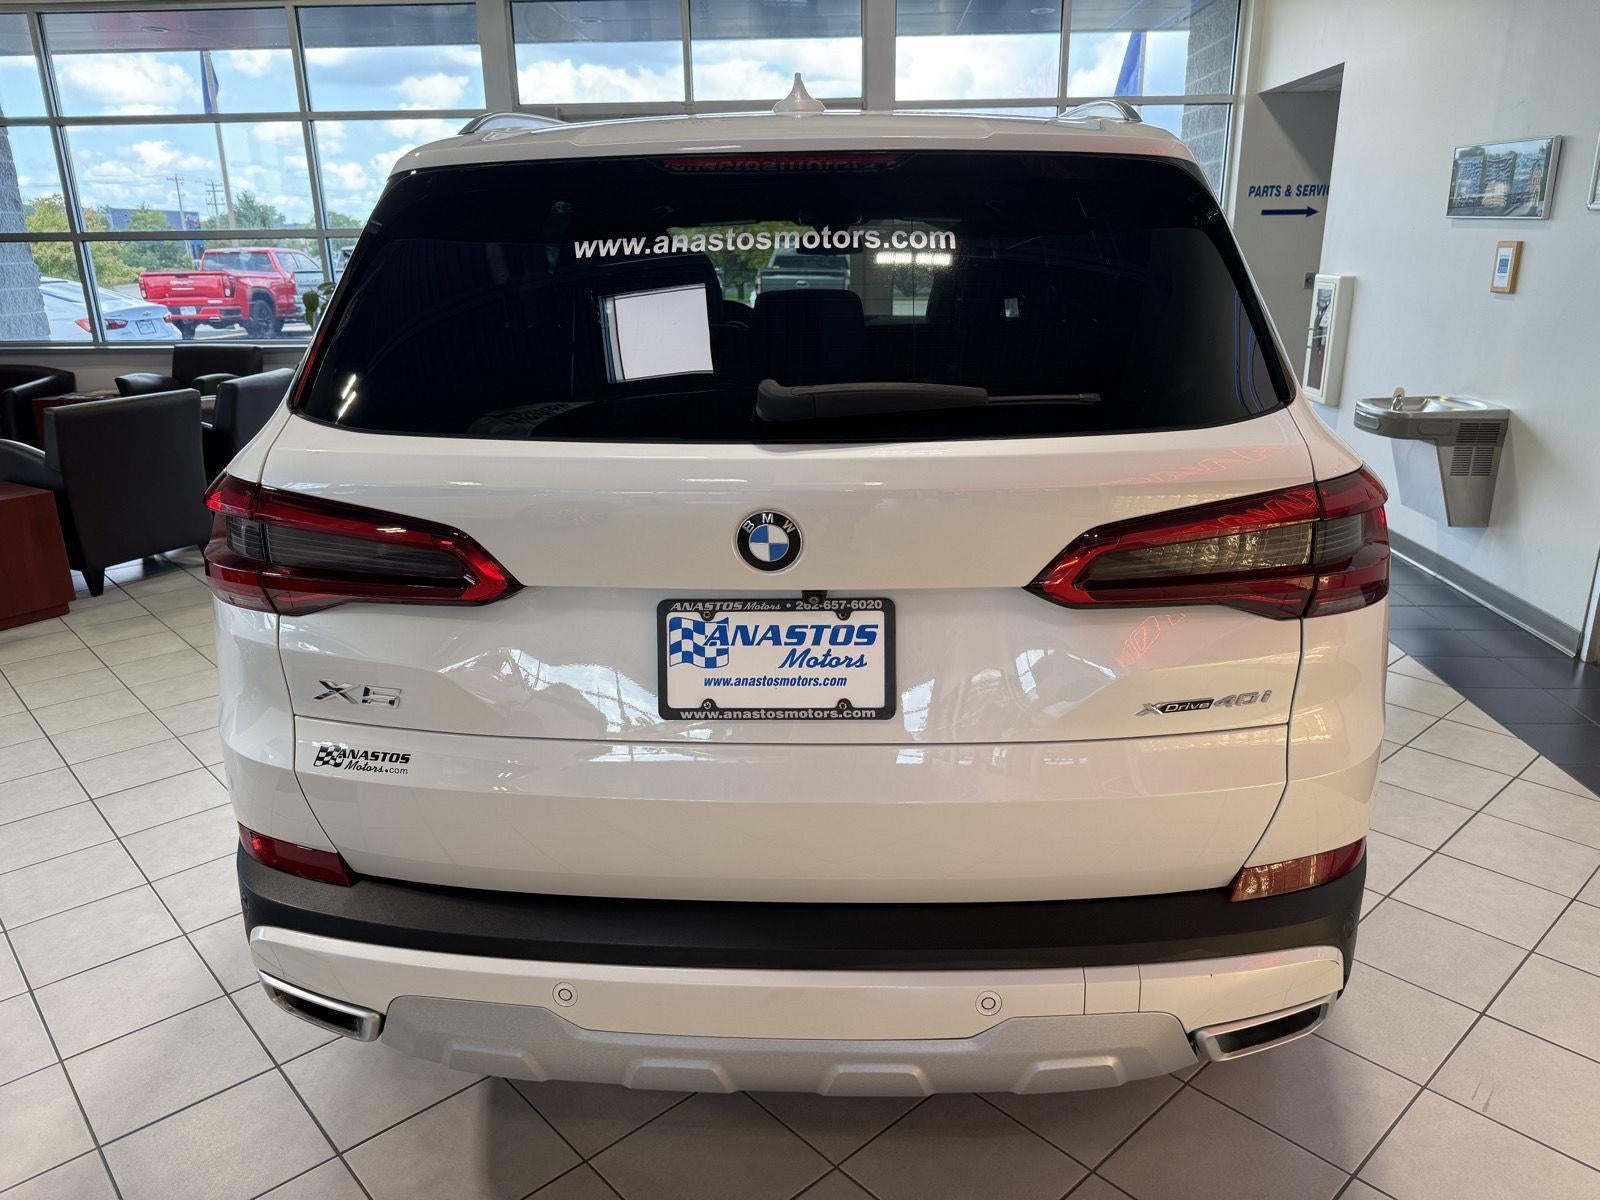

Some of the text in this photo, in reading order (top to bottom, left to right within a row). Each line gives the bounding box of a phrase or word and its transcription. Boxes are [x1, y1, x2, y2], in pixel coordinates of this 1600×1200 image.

[1248, 184, 1282, 198] PARTS
[1284, 185, 1293, 197] &
[574, 225, 957, 259] www.anastosmotors.com
[742, 513, 797, 534] BMW
[670, 601, 743, 611] ANASTOS
[743, 601, 781, 611] Motors
[703, 624, 879, 647] ANASTOS
[778, 648, 868, 669] Motors
[703, 675, 848, 688] www.anastosmotors.com
[313, 680, 403, 710] X5
[1213, 690, 1272, 707] 40i
[680, 708, 876, 720] www.anastosmotors.com
[337, 749, 412, 764] ANASTOS
